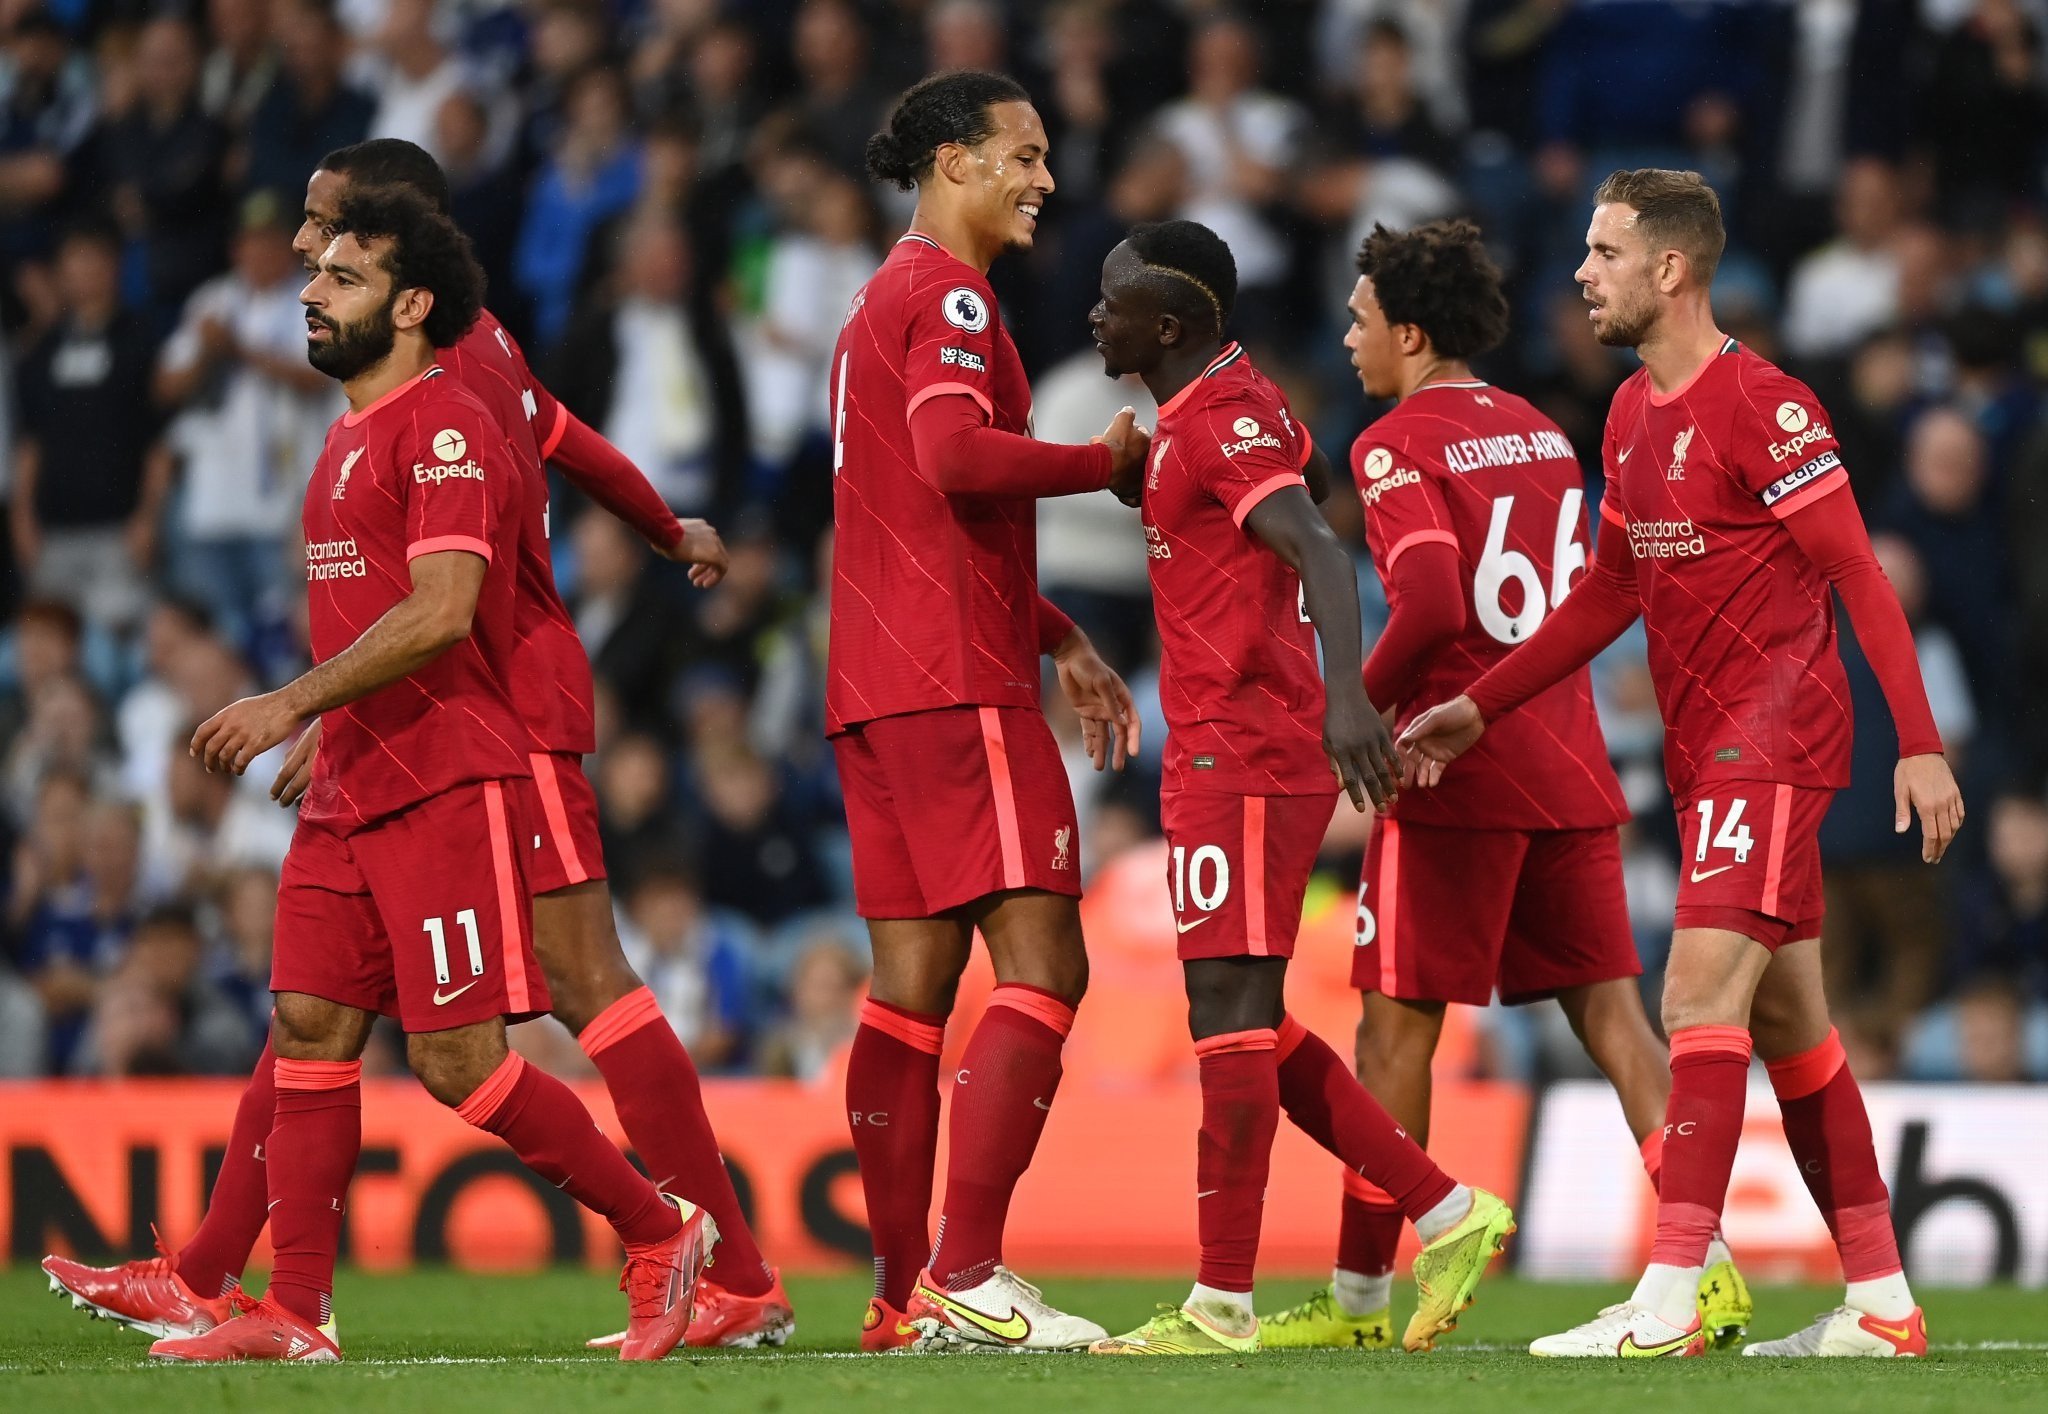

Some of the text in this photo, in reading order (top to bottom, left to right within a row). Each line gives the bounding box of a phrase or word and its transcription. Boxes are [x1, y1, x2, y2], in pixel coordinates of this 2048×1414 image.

[1221, 433, 1281, 458] Expedia
[1444, 430, 1577, 475] ALEXANDER-ARNO
[1783, 451, 1837, 485] Captai
[413, 459, 485, 485] Expedia
[307, 556, 367, 581] harered
[1474, 488, 1586, 645] 66
[1696, 798, 1755, 863] 14
[1173, 844, 1229, 912] 10
[422, 908, 484, 985] 11
